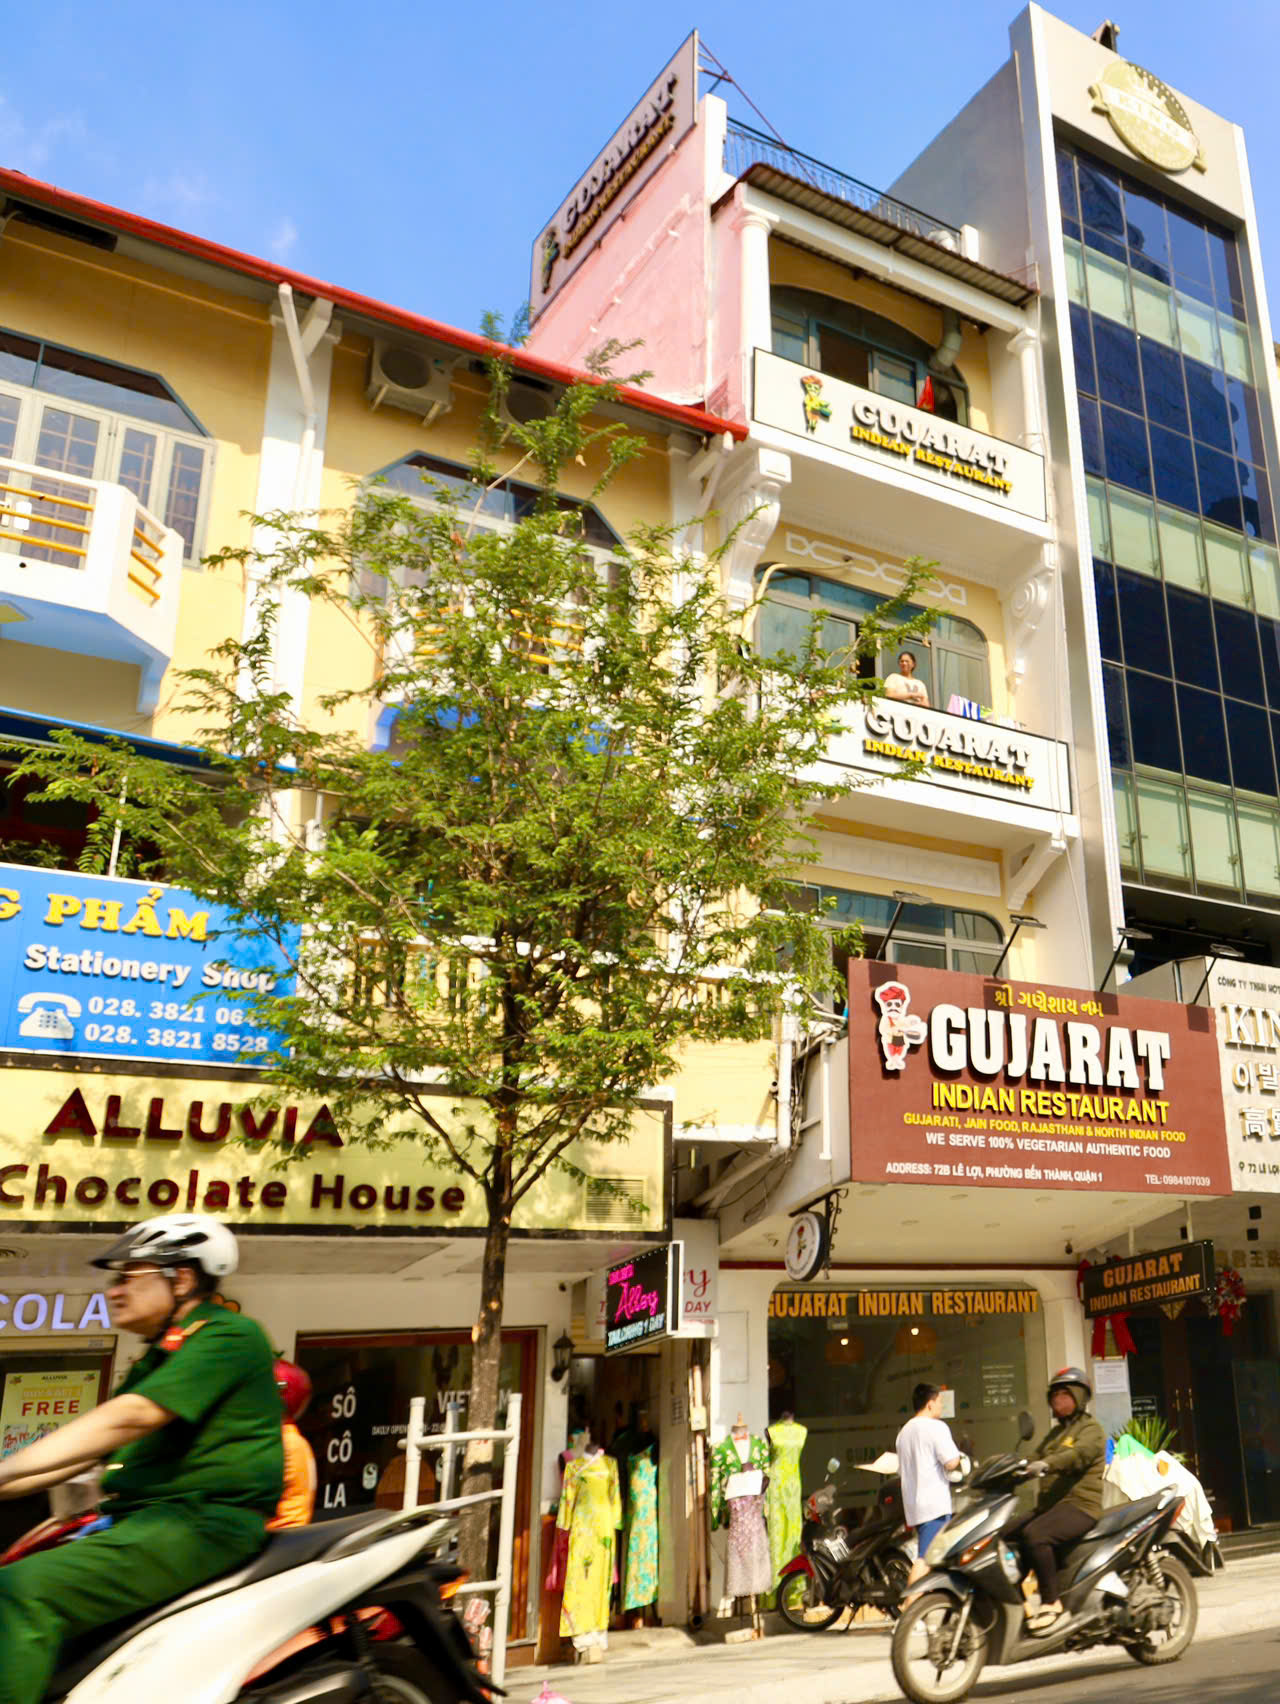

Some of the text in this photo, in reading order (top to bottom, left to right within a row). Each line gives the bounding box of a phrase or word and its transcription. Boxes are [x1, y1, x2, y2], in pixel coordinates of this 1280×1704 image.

[853, 400, 1009, 474] GUJARAT
[851, 426, 1013, 493] INDIAN RESTAURANT
[865, 711, 1032, 768] GUJARAT
[864, 738, 1035, 791] INDIAN RESTAURANT
[44, 887, 210, 941] PHẨM
[24, 944, 192, 987] Stationery
[88, 996, 141, 1017] 028.
[149, 1001, 206, 1022] 3821
[84, 1023, 270, 1053] 028. 3821 8528
[931, 1003, 1171, 1091] GUJARAT
[44, 1087, 344, 1148] ALLUVIA
[932, 1082, 1170, 1125] INDIAN RESTAURANT
[903, 1112, 1186, 1143] GUJARATI, JAIN FOOD, RAJASTHANI & NORTH INDIAN FOOD
[926, 1132, 1171, 1158] WE SERVE 100% VEGETARIAN AUTHENTIC FOOD
[0, 1162, 465, 1213] Chocolate House
[886, 1162, 932, 1175] ADDRESS:
[934, 1164, 950, 1176] 72B
[952, 1162, 964, 1176] LÊ
[966, 1165, 984, 1180] LỢI,
[1025, 1163, 1042, 1179] BẾN
[1074, 1168, 1097, 1183] QUẬN
[1103, 1252, 1184, 1288] GUJARAT
[768, 1290, 1039, 1318] GUJARAT INDIAN RESTAURANT
[1089, 1274, 1201, 1312] INDIAN RESTAURANT
[21, 1399, 80, 1416] FREE
[331, 1386, 357, 1419] SÔ
[327, 1430, 352, 1464] CÔ
[324, 1483, 347, 1509] LA
